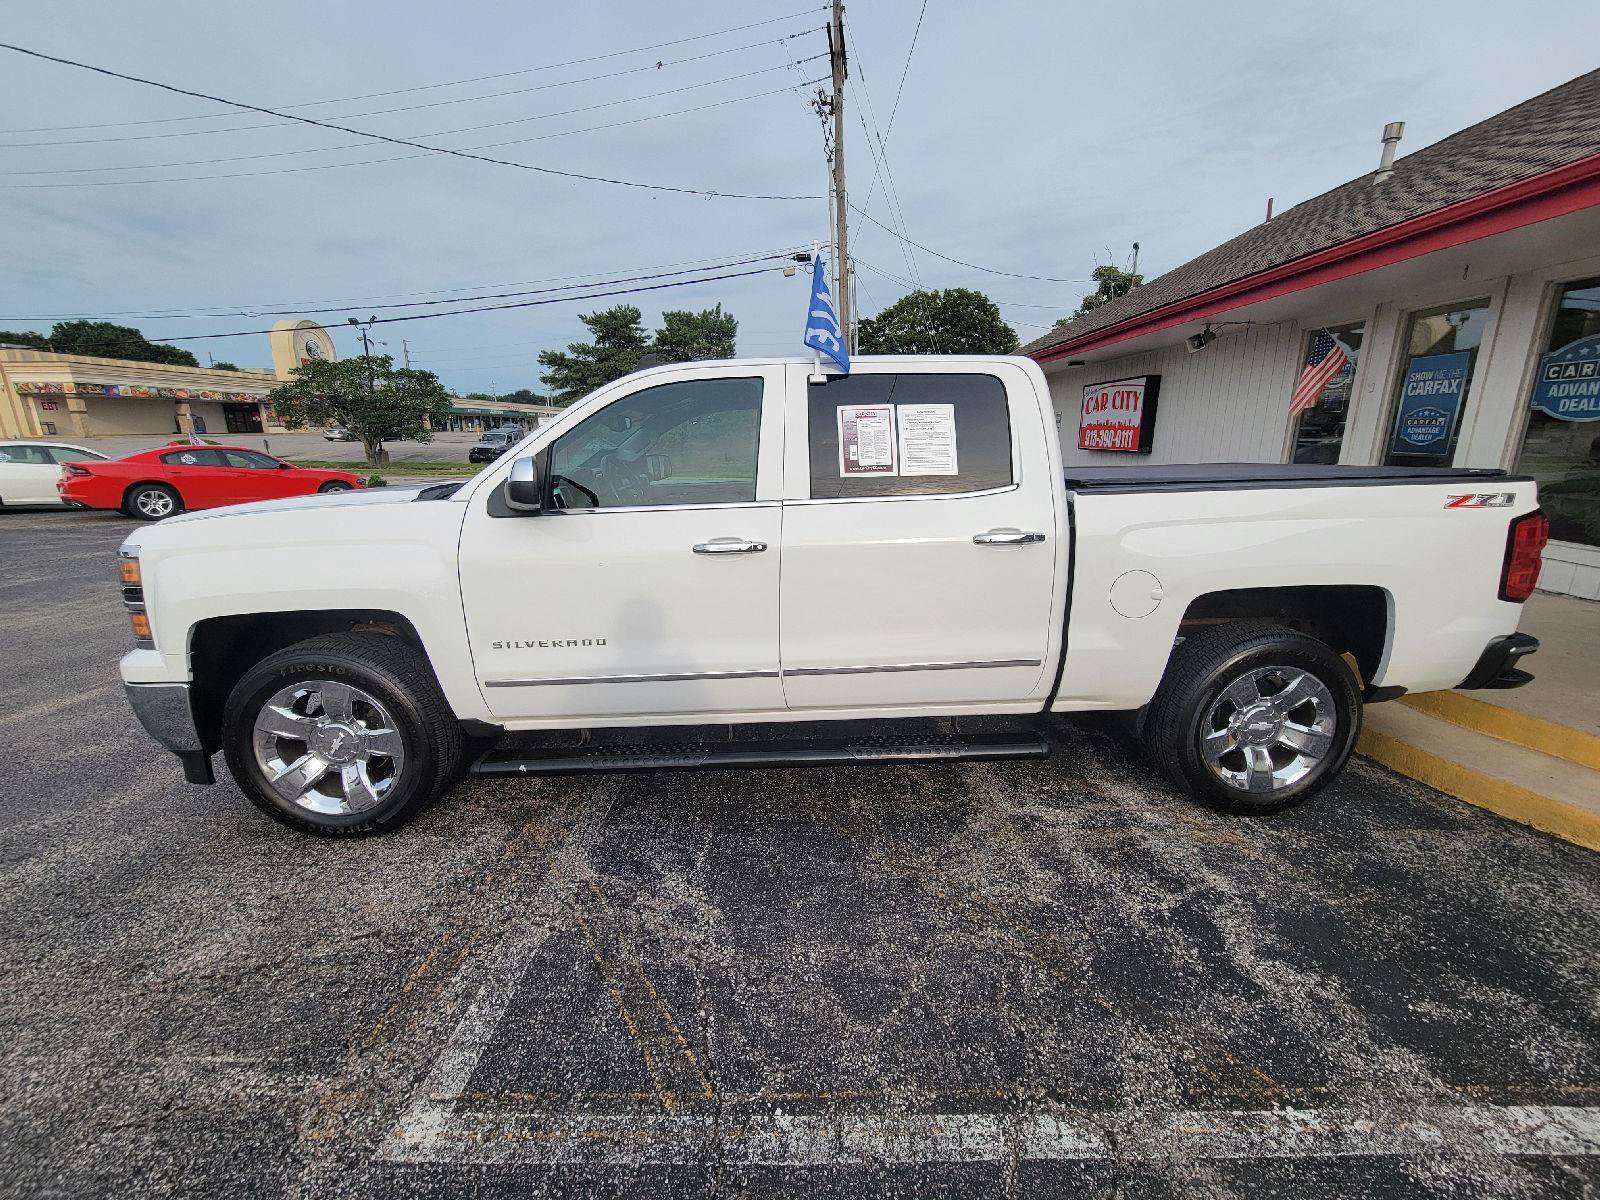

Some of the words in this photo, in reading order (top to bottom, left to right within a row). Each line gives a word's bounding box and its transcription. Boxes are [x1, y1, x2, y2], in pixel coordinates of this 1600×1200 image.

[1410, 371, 1435, 382] SHOW
[1407, 378, 1462, 396] CARFAX
[41, 401, 59, 411] EBT
[1085, 393, 1108, 414] CAR
[1112, 391, 1141, 412] CITY
[1407, 426, 1440, 434] ADVANTAGE
[1085, 430, 1133, 447] 913-390-0111
[1411, 433, 1433, 441] DEALER
[1443, 493, 1516, 509] Z71
[492, 638, 607, 649] SILVERADO
